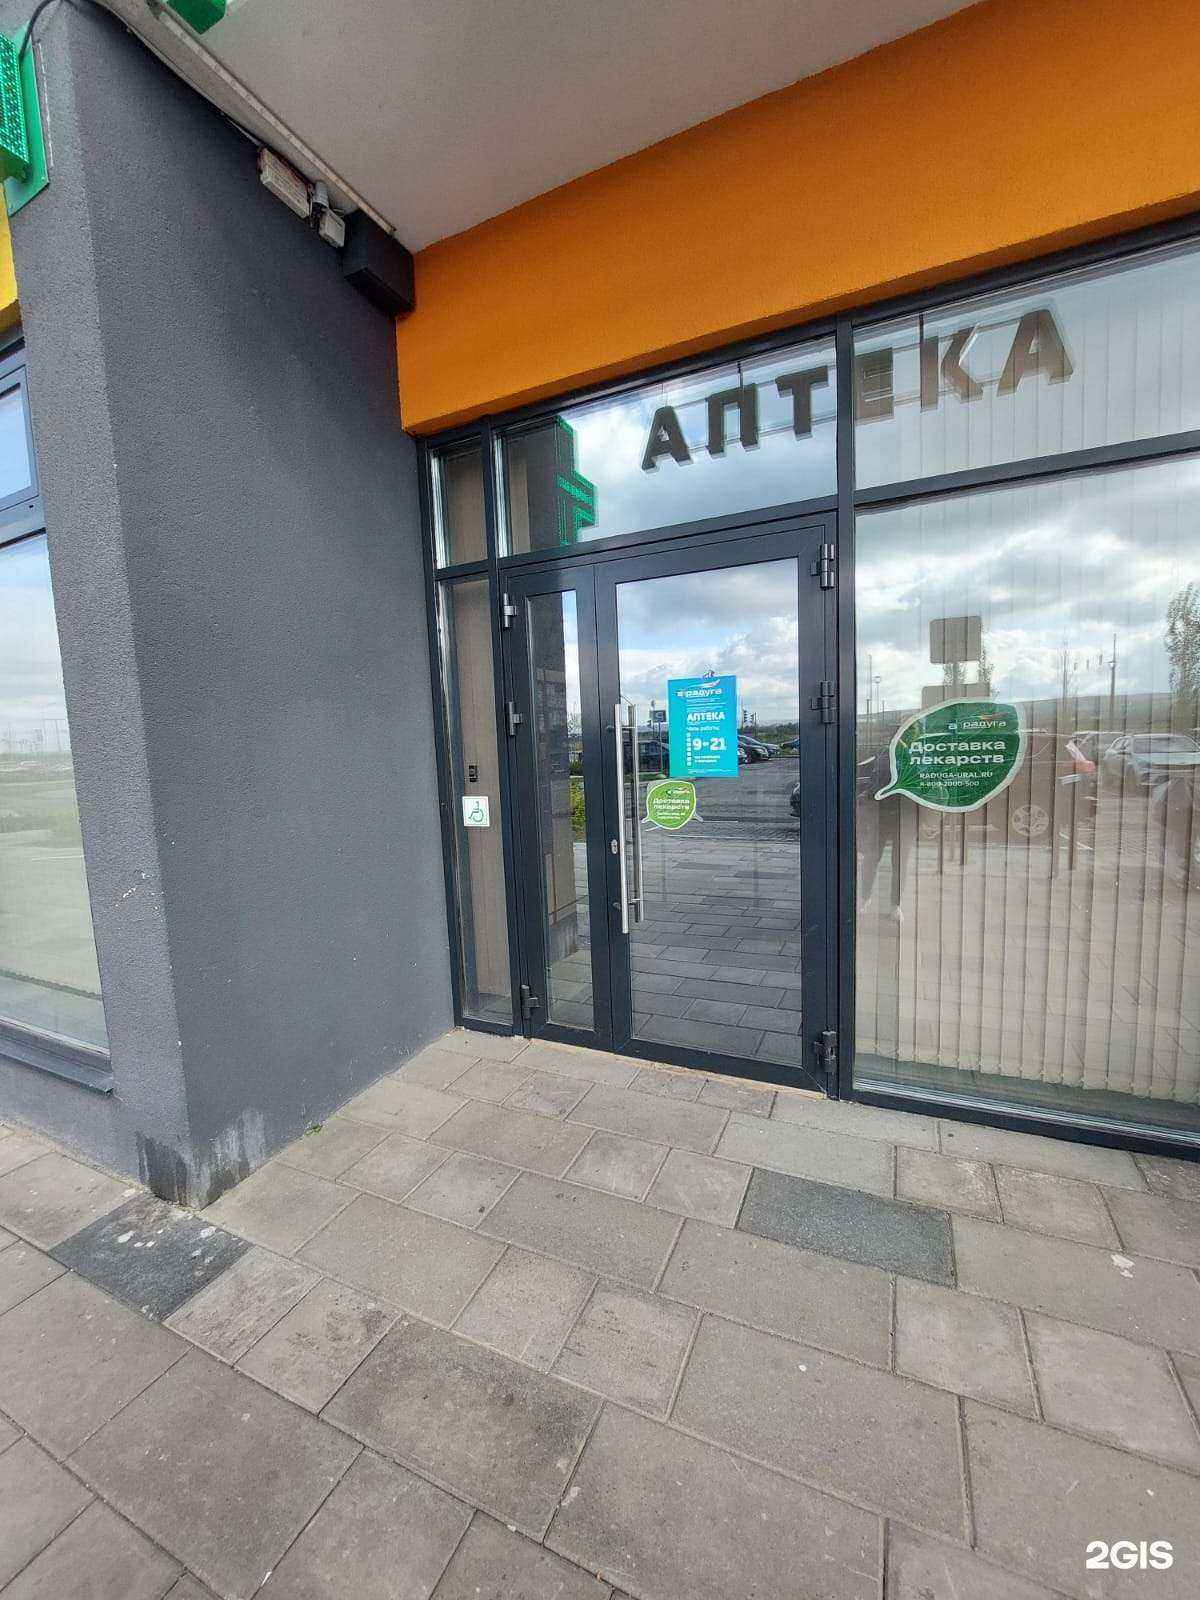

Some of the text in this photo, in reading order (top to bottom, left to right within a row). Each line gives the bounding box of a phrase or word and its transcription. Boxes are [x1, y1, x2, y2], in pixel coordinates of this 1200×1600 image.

[640, 309, 1075, 474] АПТЕКА
[687, 711, 726, 722] АПТЕКА
[961, 720, 1007, 731] радуга
[909, 741, 1007, 755] Доставка
[909, 754, 1005, 767] лекарств
[919, 771, 993, 780] RADUGA-URAL.RU
